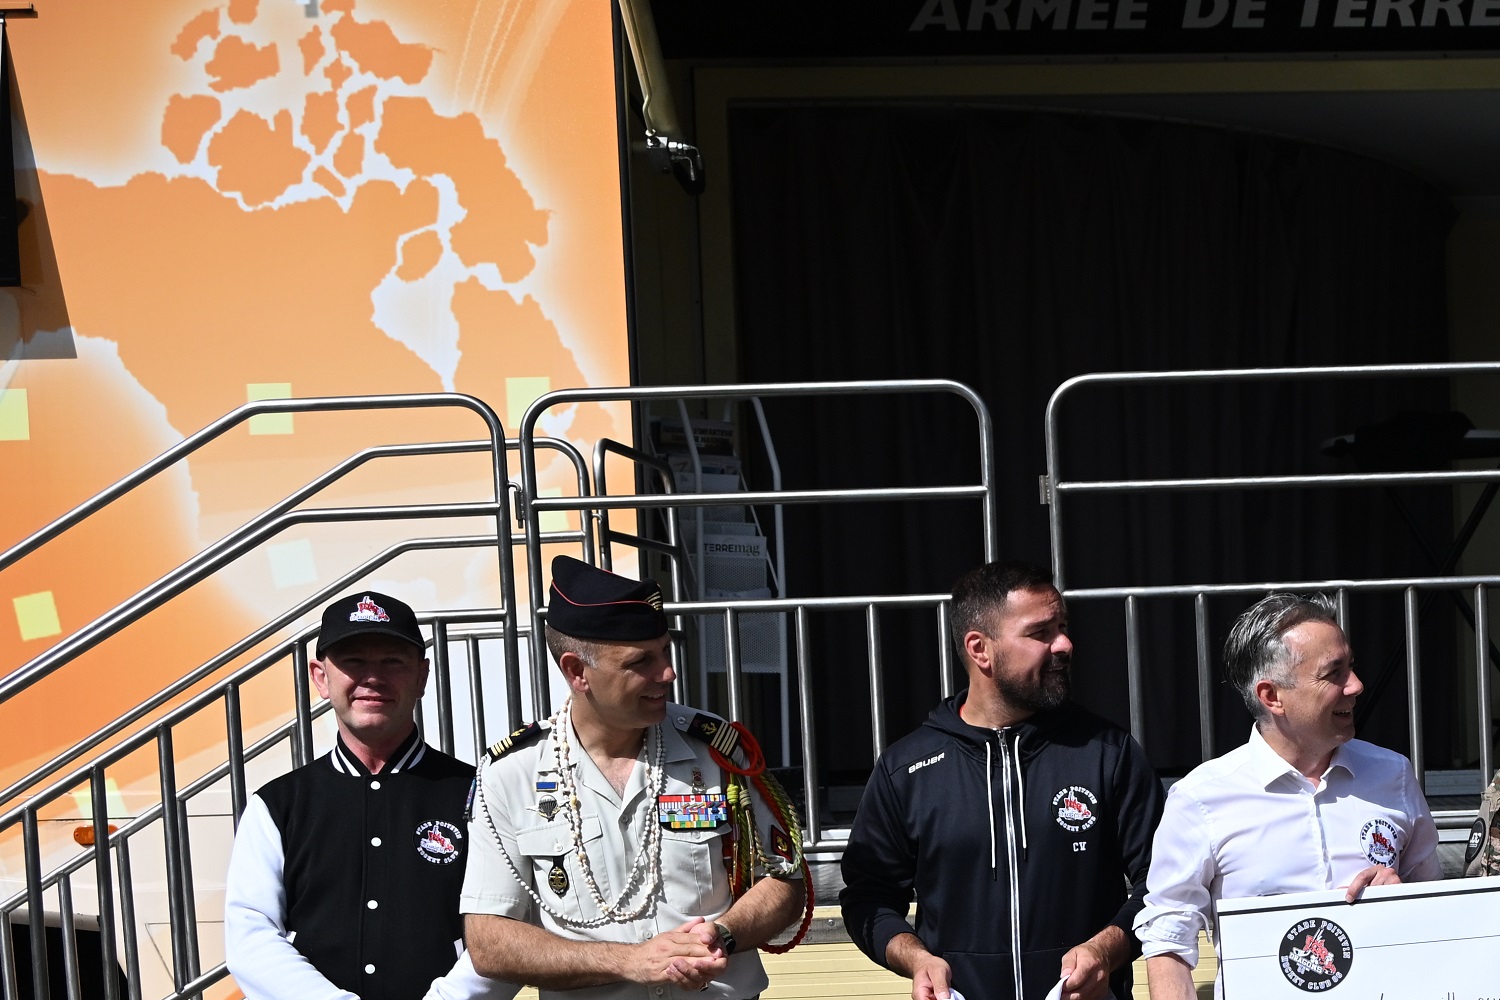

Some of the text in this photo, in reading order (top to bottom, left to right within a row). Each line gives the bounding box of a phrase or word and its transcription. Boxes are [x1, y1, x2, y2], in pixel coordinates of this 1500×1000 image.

[1181, 0, 1266, 29] DE
[1072, 841, 1087, 852] CV
[1286, 919, 1351, 959] STADE POITEVIN
[1280, 955, 1306, 987] HOCKEY
[1307, 978, 1332, 990] CLUB
[1288, 951, 1324, 975] DRAGONS
